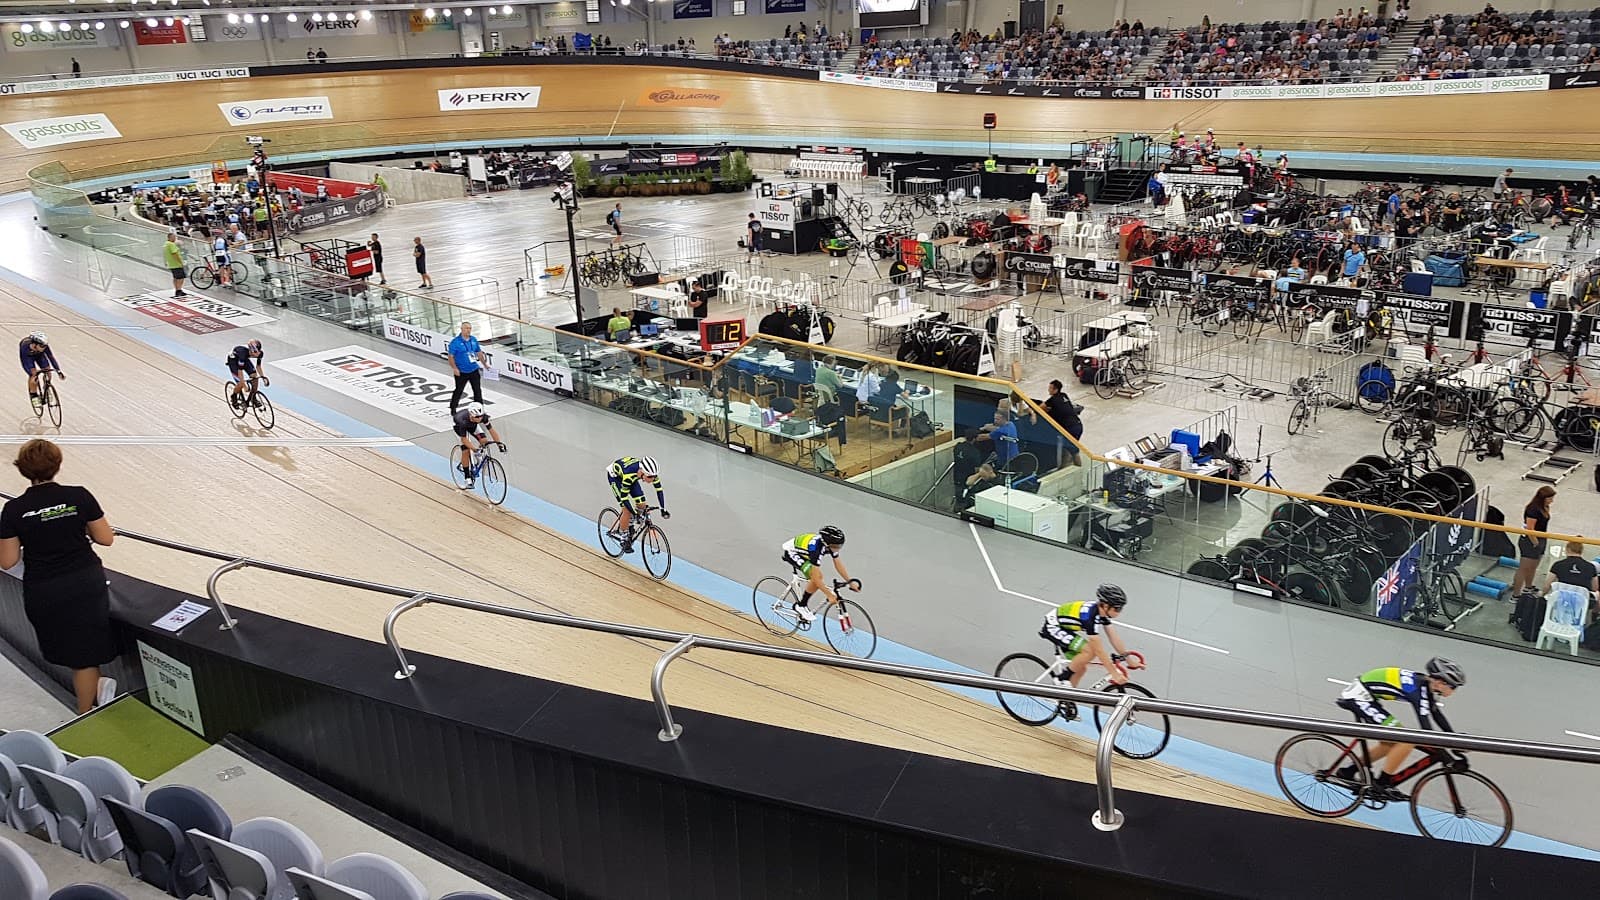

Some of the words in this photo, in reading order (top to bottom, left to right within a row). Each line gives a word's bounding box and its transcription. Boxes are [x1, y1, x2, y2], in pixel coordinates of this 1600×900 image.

[316, 19, 360, 30] PERRY
[1172, 88, 1222, 98] TISSOT
[1279, 86, 1320, 96] grassroots
[1328, 86, 1371, 96] grassroots
[1379, 82, 1425, 94] grassroots
[1434, 79, 1482, 92] grassroots
[1491, 77, 1543, 89] grassroots
[467, 92, 531, 103] PERRY
[19, 119, 101, 142] grassroots
[760, 211, 790, 222] TISSOT
[1404, 299, 1448, 312] TISSOT
[1505, 311, 1555, 323] TISSOT
[401, 328, 432, 347] TISSOT
[723, 323, 740, 341] 12
[524, 364, 564, 387] TISSOT
